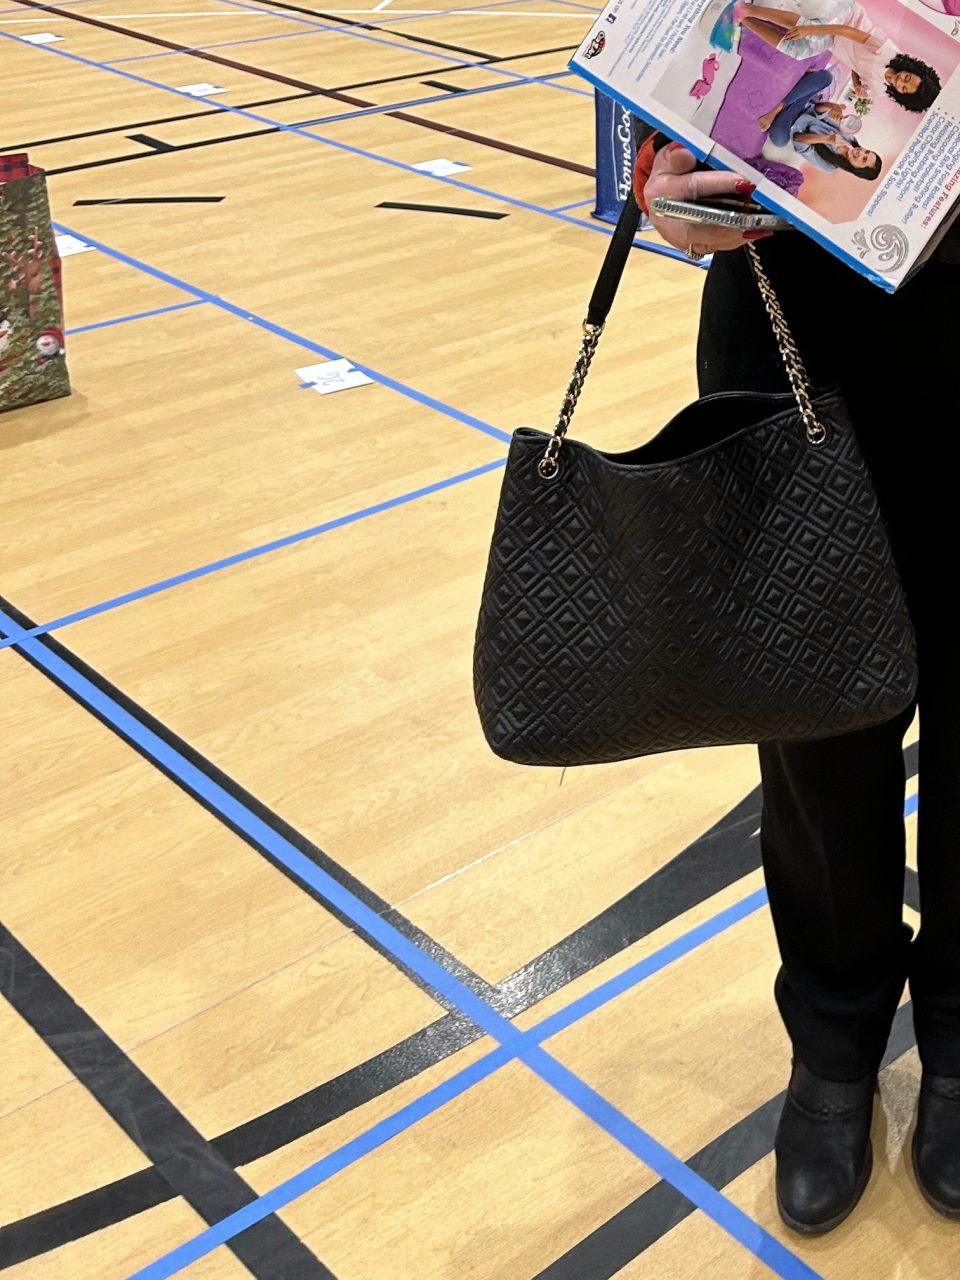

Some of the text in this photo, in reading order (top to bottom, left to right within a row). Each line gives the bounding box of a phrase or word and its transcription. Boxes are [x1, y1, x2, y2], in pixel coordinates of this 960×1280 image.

[611, 5, 619, 13] on
[680, 23, 690, 36] You
[917, 110, 938, 138] Scented
[893, 115, 945, 188] Color Changing Lights!
[931, 124, 959, 161] Cascading
[896, 119, 952, 201] Relaxing Bubbling Action!
[937, 154, 950, 169] Skin
[883, 175, 895, 190] Spa
[914, 167, 941, 203] Smoothing
[936, 170, 949, 186] Foot
[865, 188, 887, 217] Slippers!
[920, 191, 948, 230] Features:
